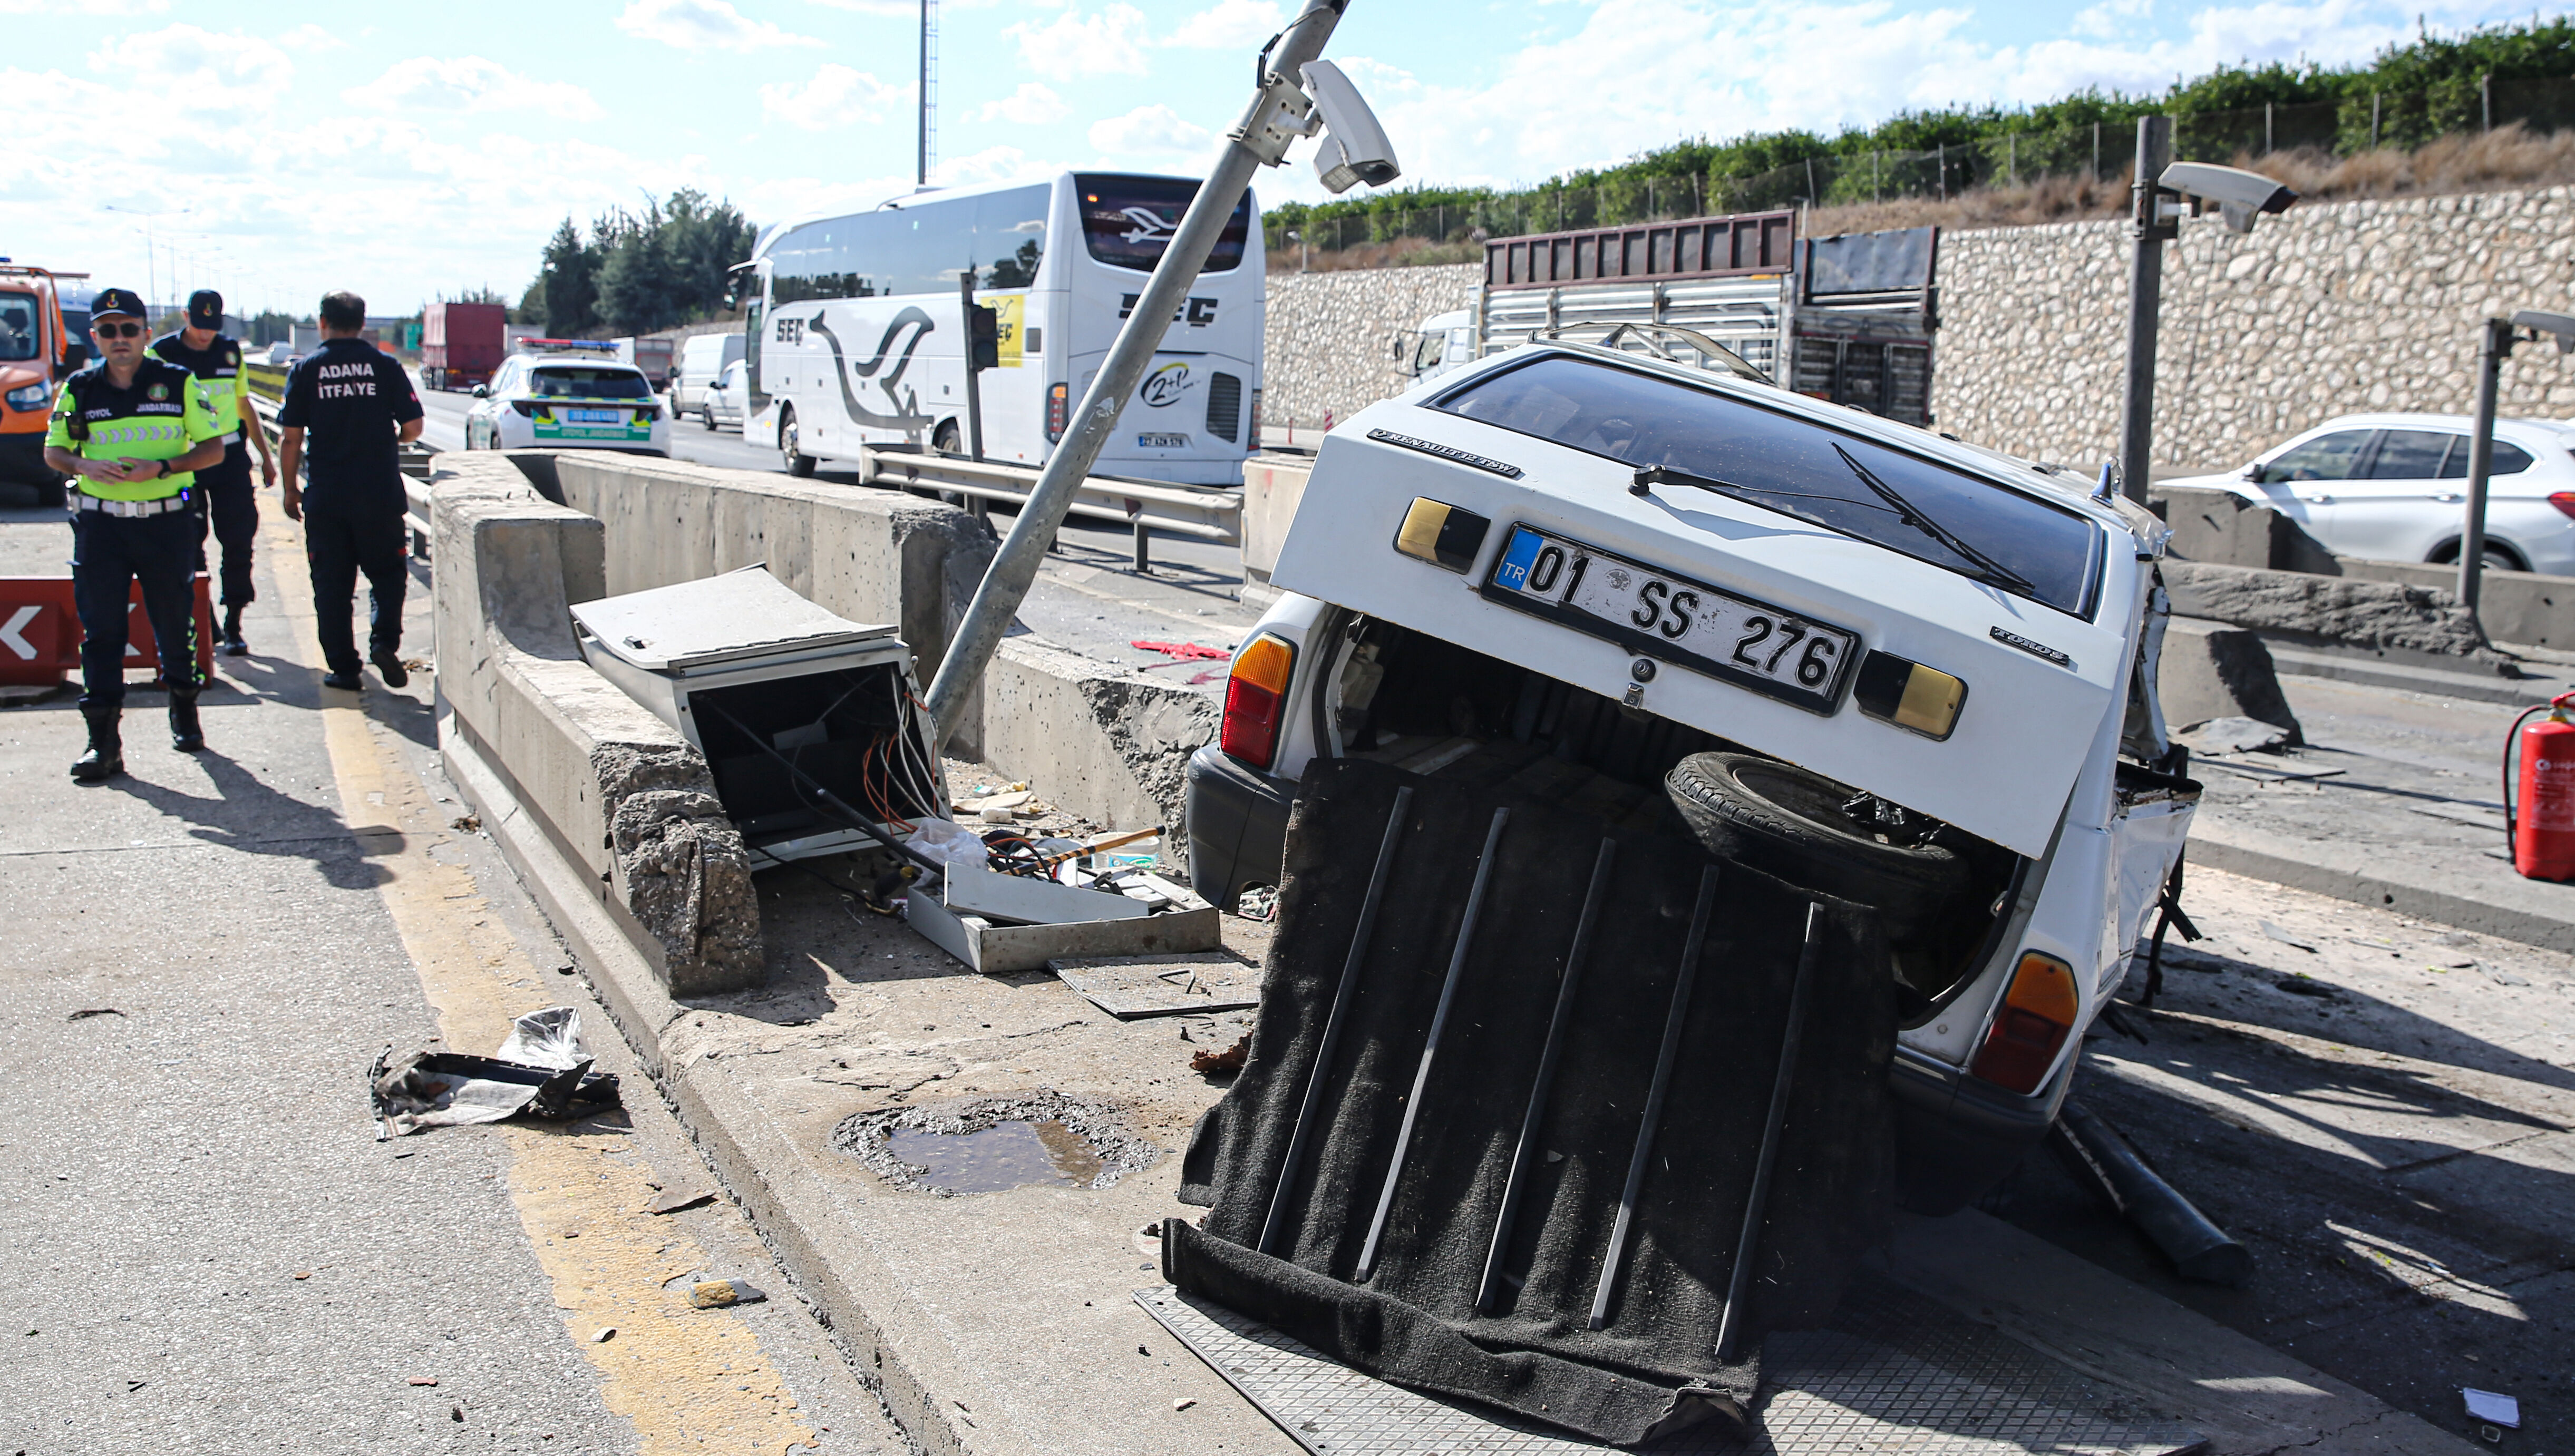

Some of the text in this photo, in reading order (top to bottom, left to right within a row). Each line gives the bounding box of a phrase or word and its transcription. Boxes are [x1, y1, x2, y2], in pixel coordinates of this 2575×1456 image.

[318, 364, 374, 379] ADANA
[85, 408, 112, 420] TOYOL
[1388, 433, 1514, 473] RENAULT 12 TSW
[1504, 546, 1835, 686] TR 01 SS 276
[1995, 628, 2064, 659] TOROS
